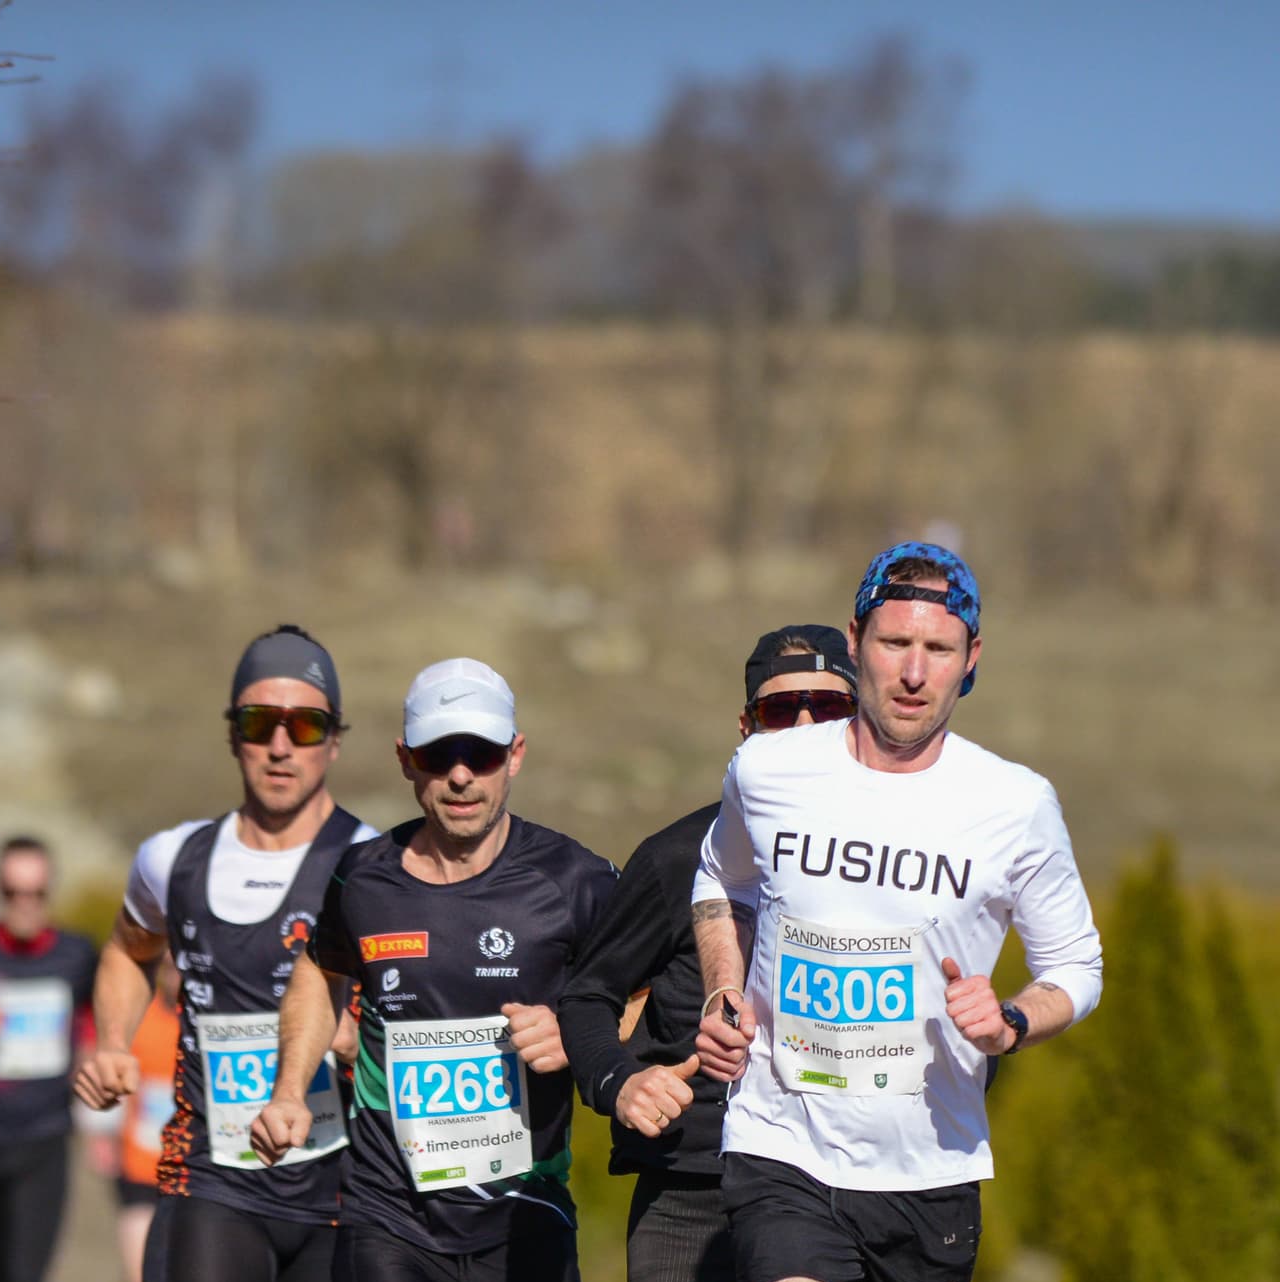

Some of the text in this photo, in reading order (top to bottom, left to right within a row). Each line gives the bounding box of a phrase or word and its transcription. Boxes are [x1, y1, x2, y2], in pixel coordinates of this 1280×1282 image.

[773, 831, 972, 899] FUSION
[379, 938, 424, 952] EXTRA
[784, 924, 911, 951] SANDNESPOSTEN
[475, 967, 520, 977] TRIMTEX
[784, 963, 907, 1021] 4306
[814, 1022, 874, 1033] HALVMARATON
[811, 1041, 915, 1060] timeanddate
[398, 1057, 513, 1115] 4268
[428, 1115, 486, 1126] HALVMARATON
[426, 1130, 523, 1153] timeanddate
